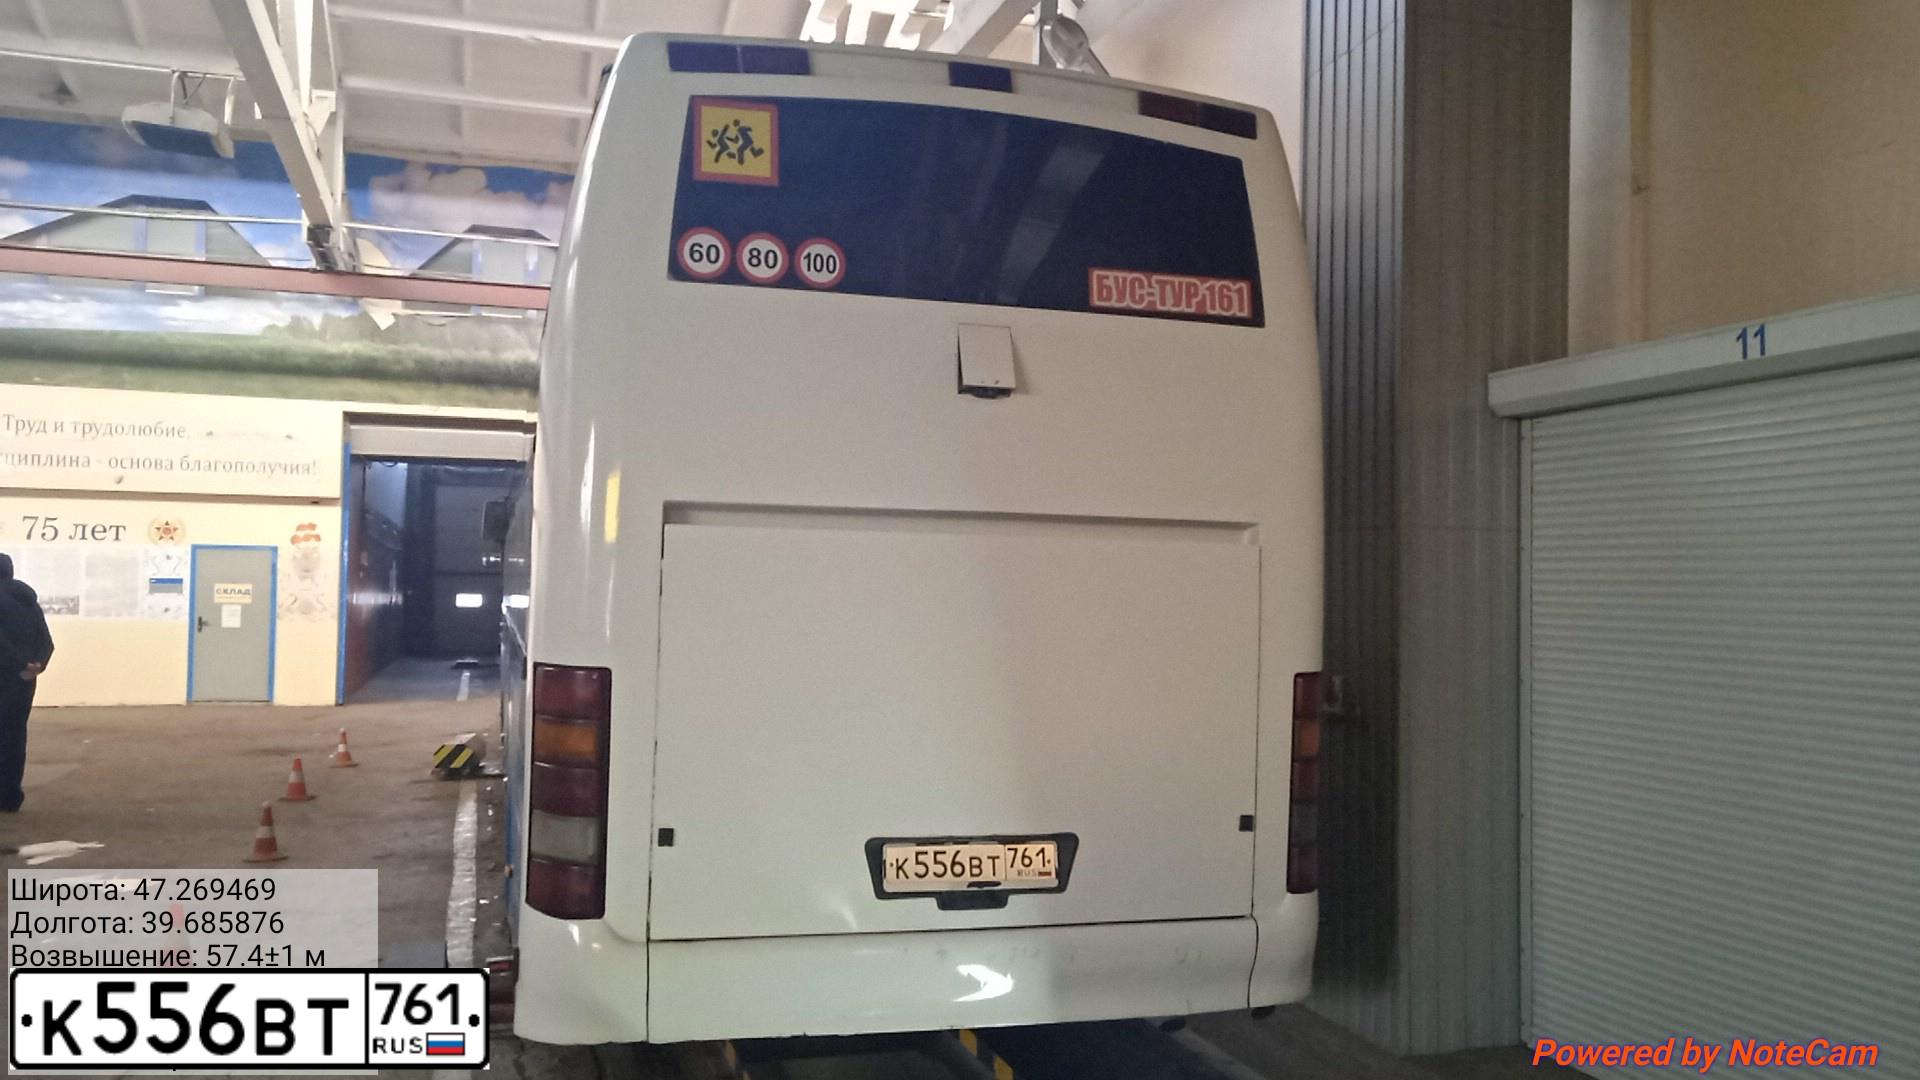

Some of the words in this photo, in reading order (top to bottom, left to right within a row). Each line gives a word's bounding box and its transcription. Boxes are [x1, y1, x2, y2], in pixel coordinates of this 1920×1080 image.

[689, 242, 721, 264] 60
[747, 247, 779, 269] 80
[803, 252, 837, 274] 100
[1093, 270, 1202, 312] БУС-ТУР
[1202, 280, 1248, 317] 161
[1736, 324, 1766, 360] 11
[2, 413, 48, 436] Труд
[54, 420, 65, 433] и
[108, 455, 174, 471] основа
[180, 453, 317, 480] благополучия!
[22, 515, 59, 542] 75
[68, 522, 127, 542] лет
[215, 588, 251, 596] СКЛАД
[895, 850, 1000, 879] К556ВТ
[1007, 847, 1046, 868] 761
[1017, 869, 1037, 877] RUS
